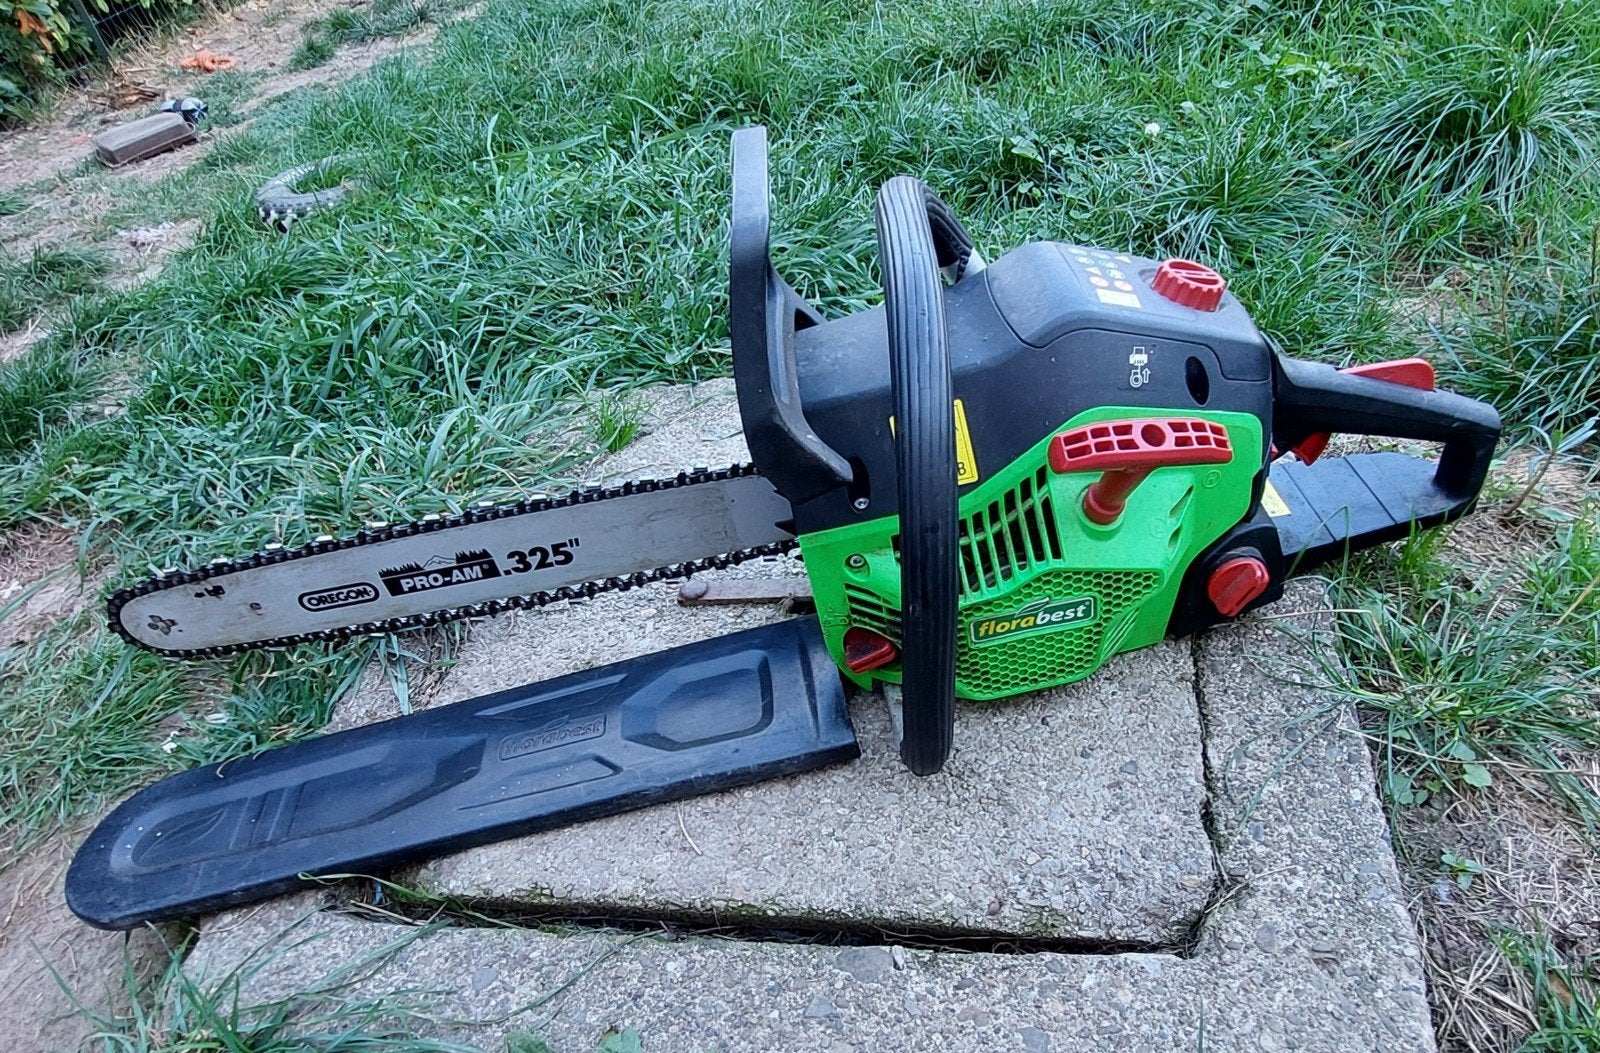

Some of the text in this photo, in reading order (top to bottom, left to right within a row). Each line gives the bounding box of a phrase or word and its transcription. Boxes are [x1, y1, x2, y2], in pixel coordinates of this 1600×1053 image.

[502, 538, 581, 576] .325"
[307, 586, 370, 607] OREGON
[978, 604, 1087, 637] florabest
